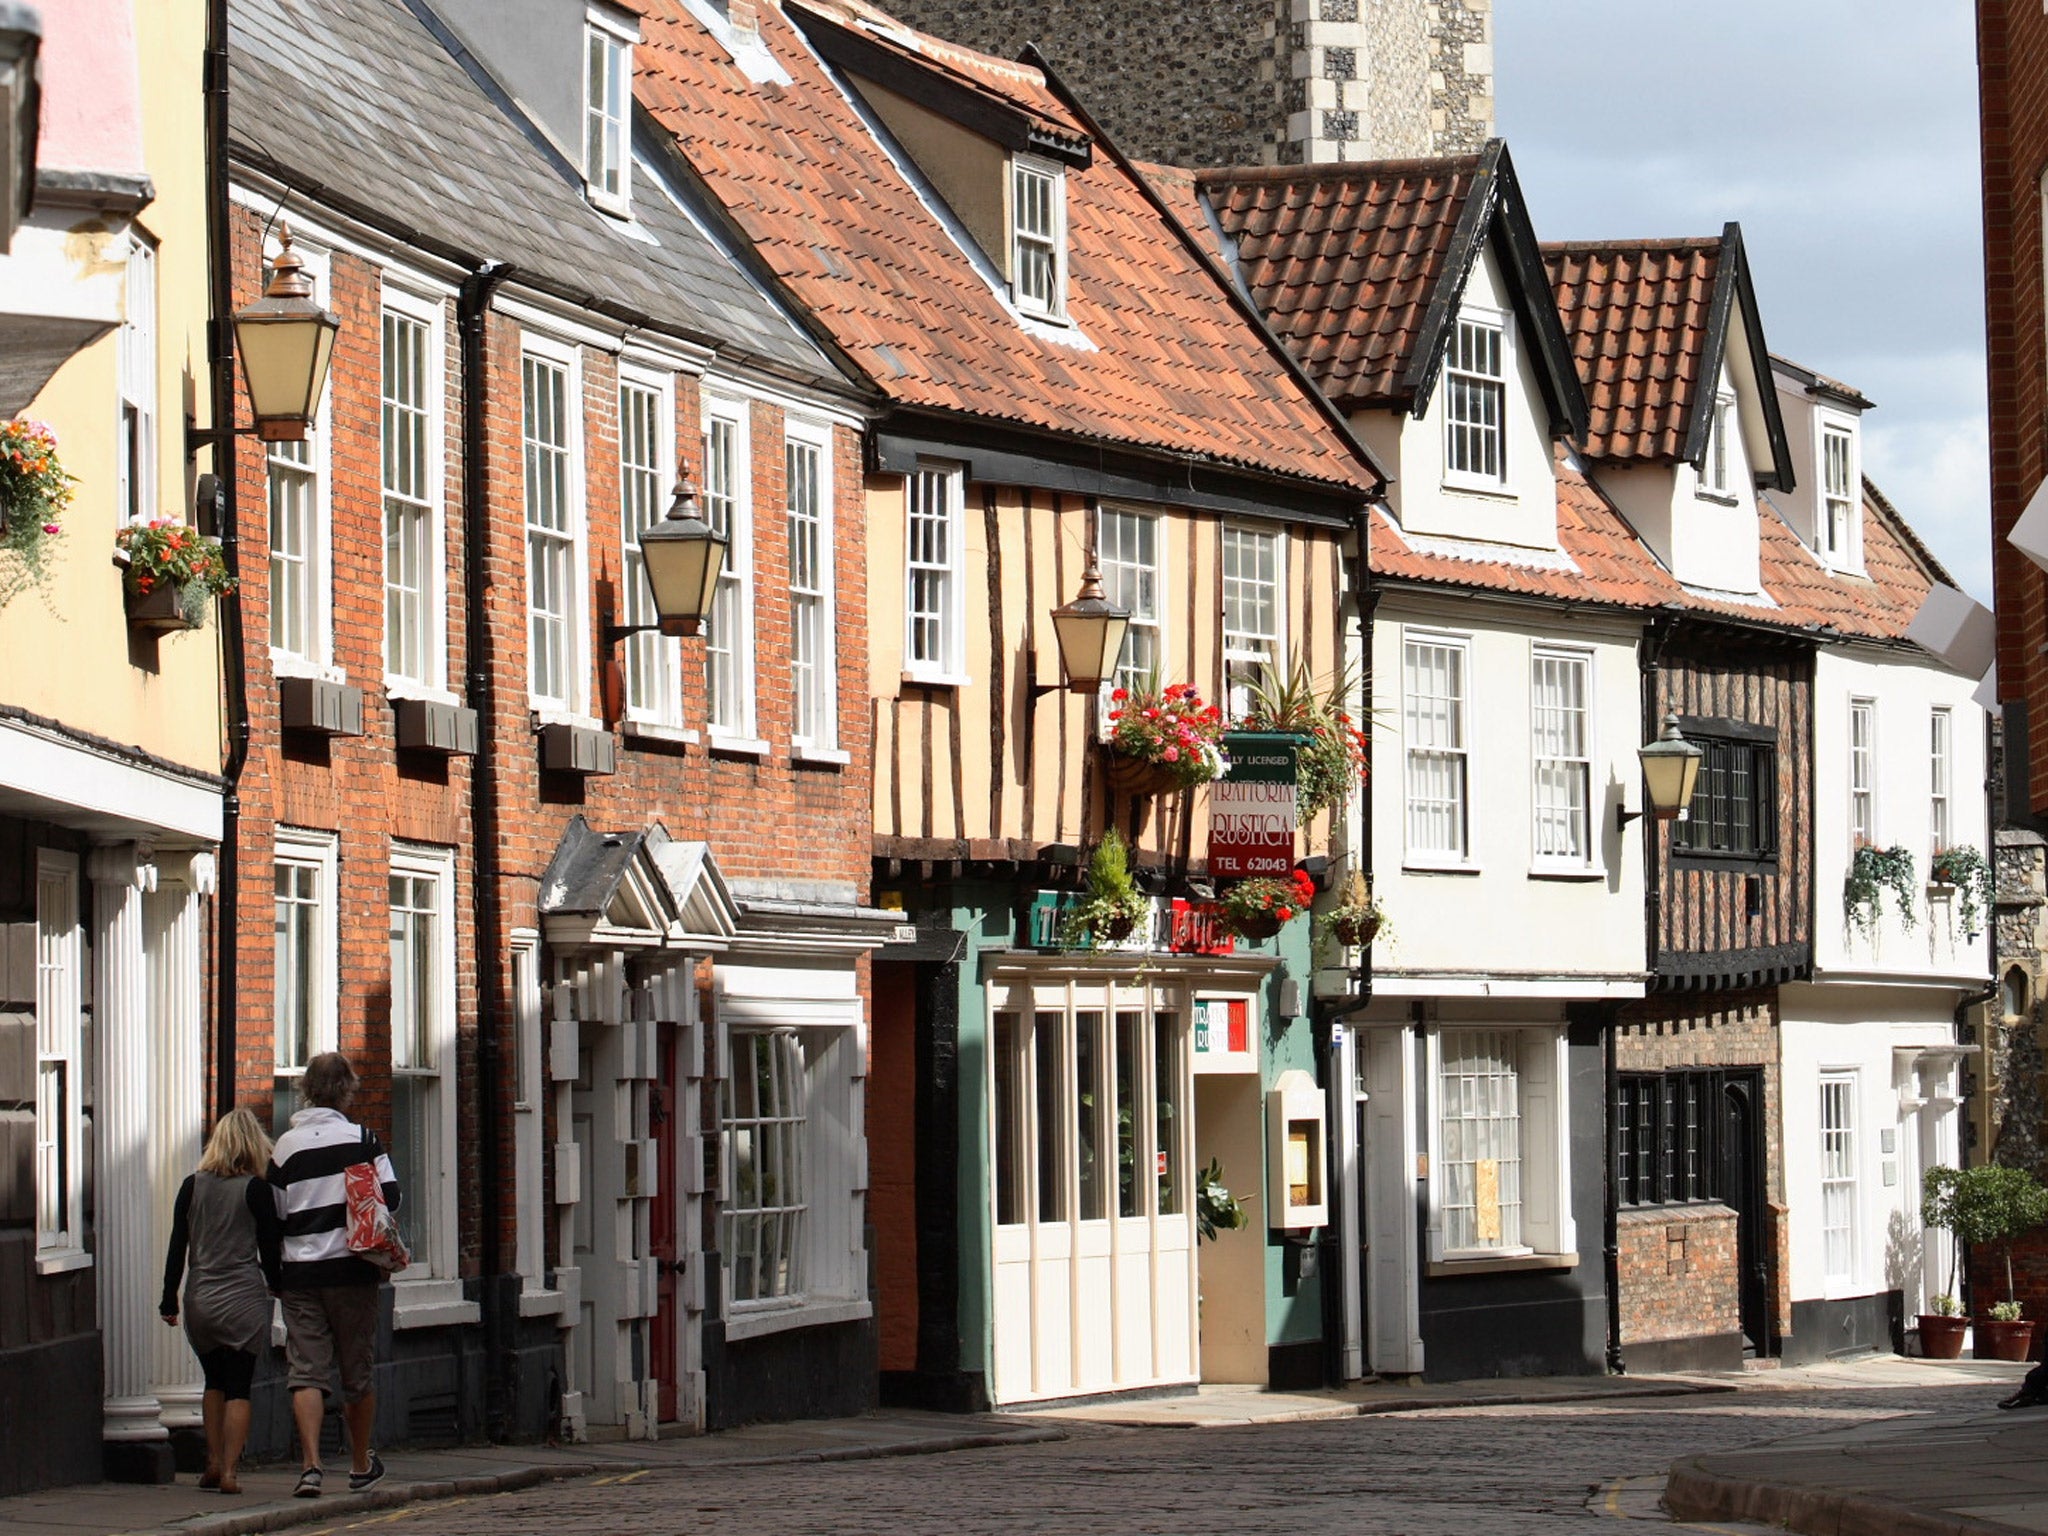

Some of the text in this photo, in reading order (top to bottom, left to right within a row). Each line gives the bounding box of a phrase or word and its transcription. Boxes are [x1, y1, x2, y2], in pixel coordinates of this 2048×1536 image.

[1248, 756, 1289, 765] LICENSED
[1213, 780, 1292, 803] TRATTORIA
[1212, 813, 1291, 847] RUSTICA
[1216, 857, 1288, 872] TEL 621043
